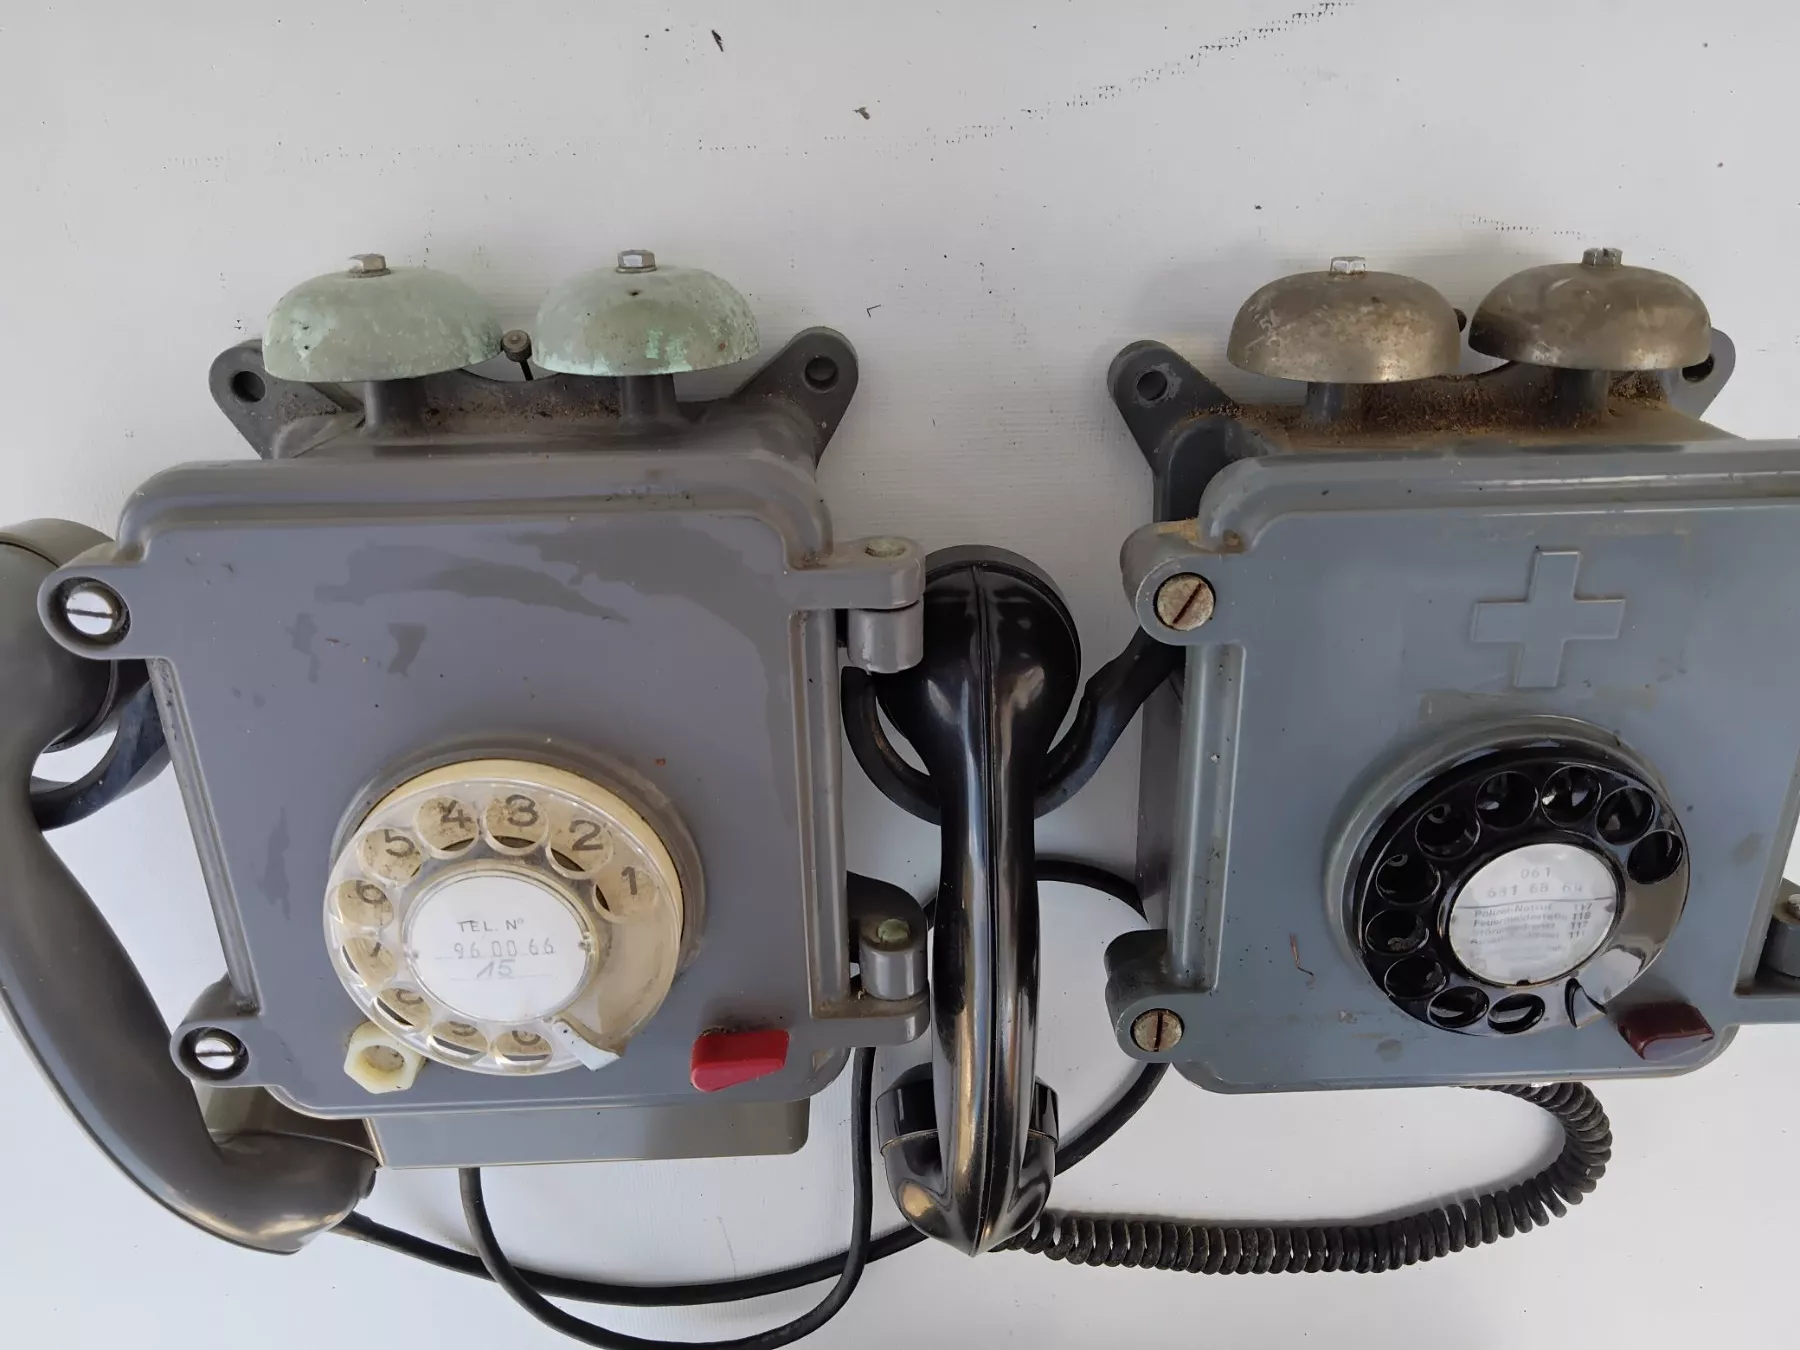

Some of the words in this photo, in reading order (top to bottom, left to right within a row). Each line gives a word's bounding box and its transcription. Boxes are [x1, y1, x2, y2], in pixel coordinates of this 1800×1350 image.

[440, 800, 473, 829] 4
[505, 794, 539, 828] 3
[384, 829, 416, 858] 5
[568, 819, 604, 852] 2
[620, 866, 639, 896] 1
